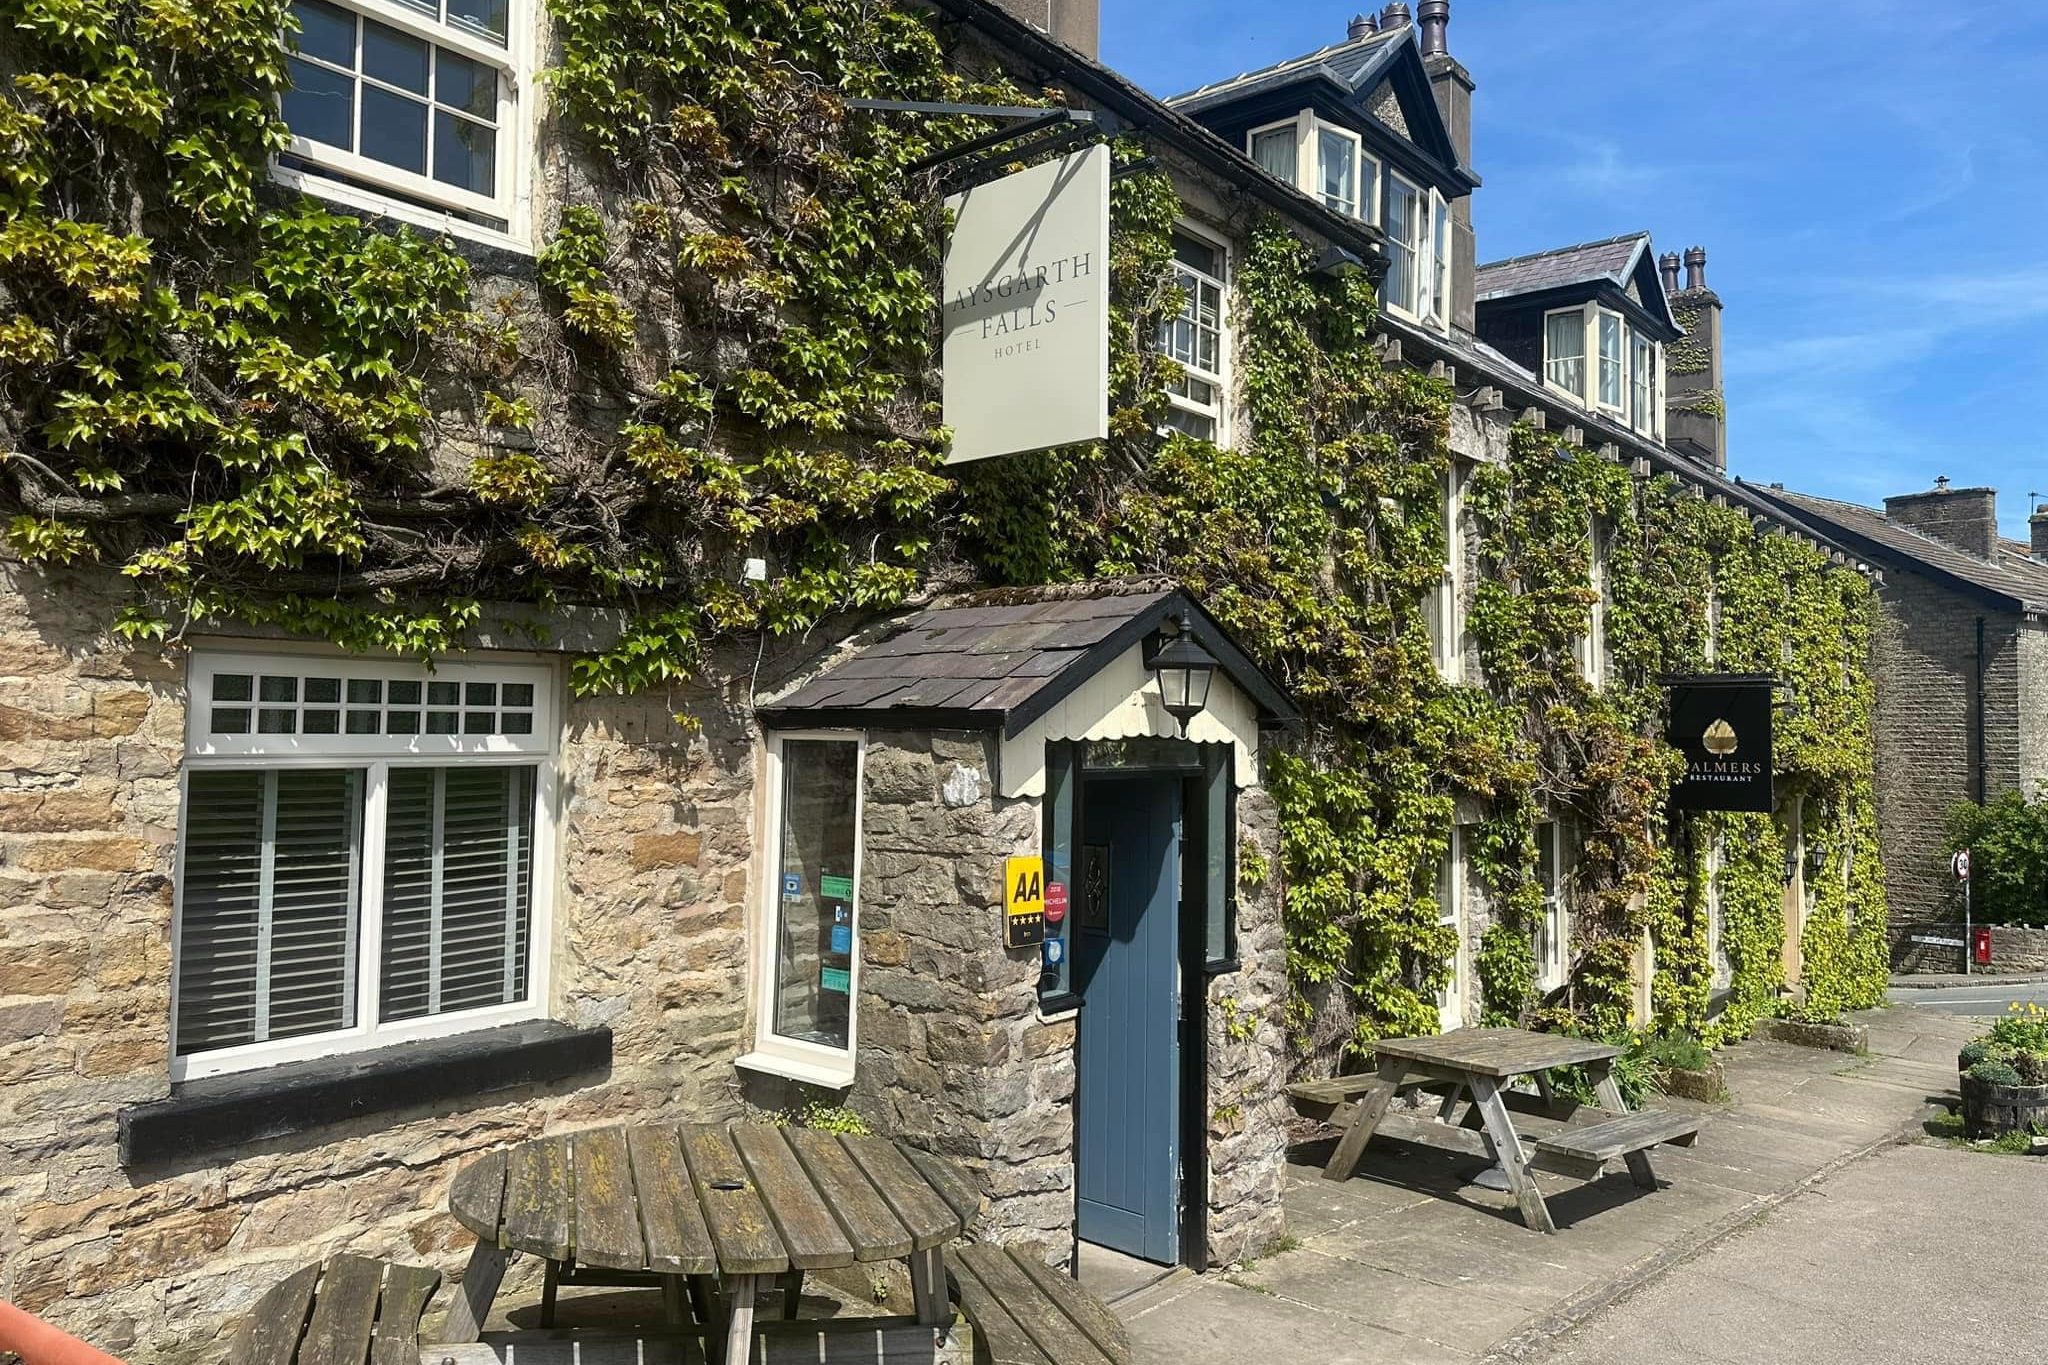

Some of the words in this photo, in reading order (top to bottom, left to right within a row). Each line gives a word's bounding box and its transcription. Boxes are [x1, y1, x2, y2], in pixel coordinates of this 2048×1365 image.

[952, 252, 1091, 312] AYSGARTH
[982, 299, 1056, 339] FALLS
[994, 338, 1041, 359] HOTEL
[1690, 774, 1752, 782] RESTAURANT
[1959, 859, 1968, 870] 30
[1013, 871, 1040, 903] AA
